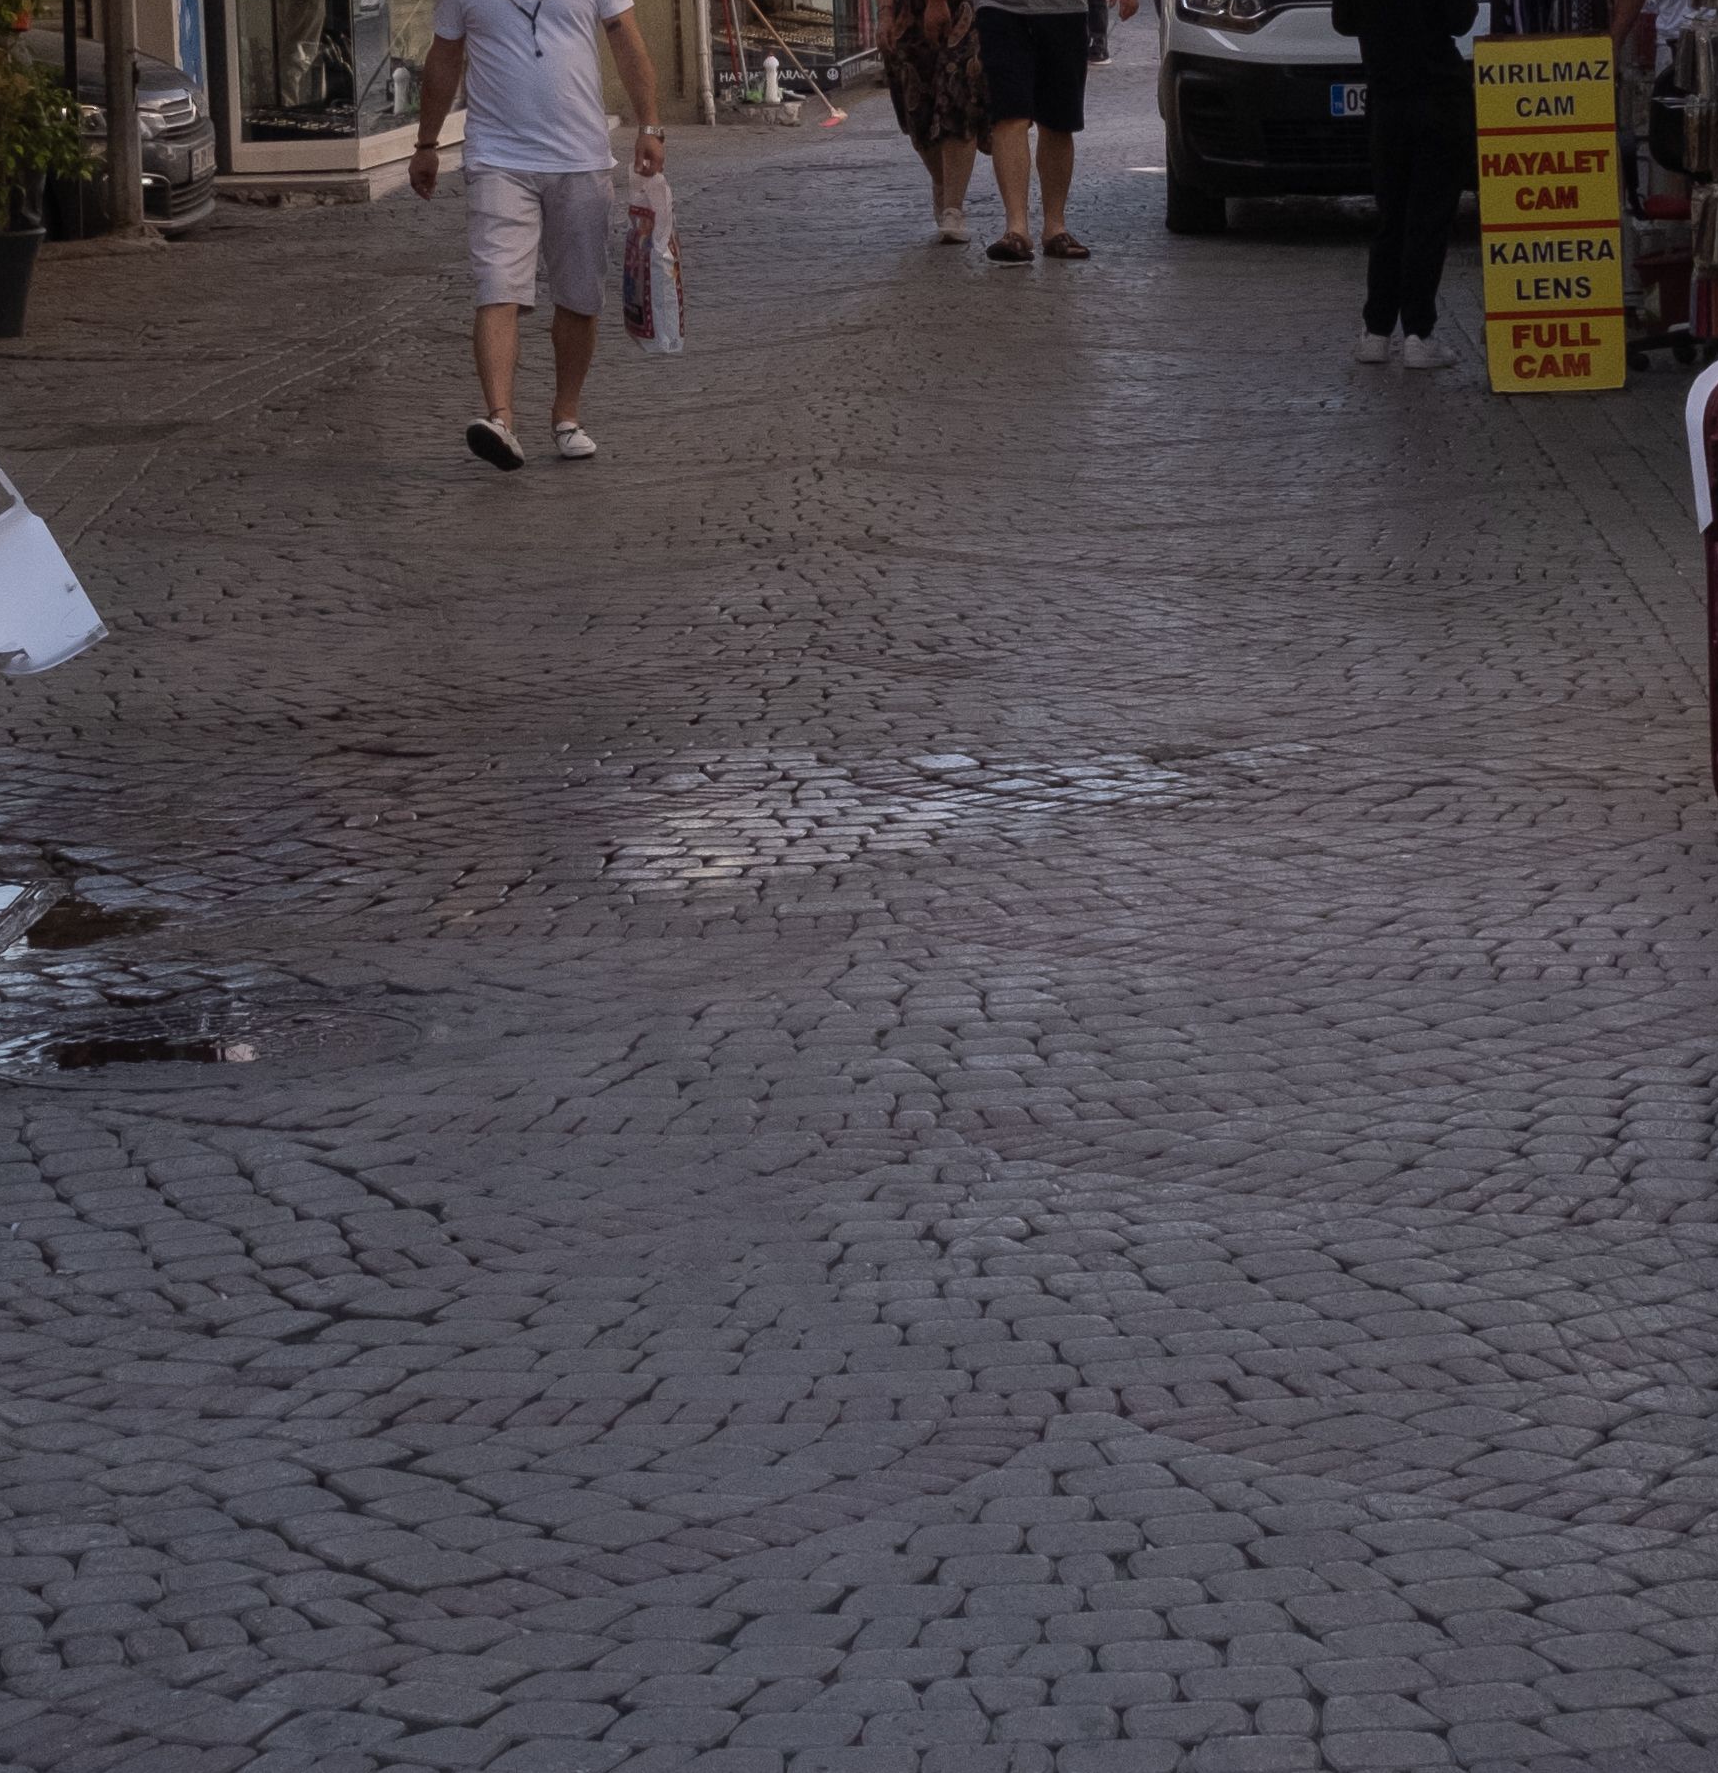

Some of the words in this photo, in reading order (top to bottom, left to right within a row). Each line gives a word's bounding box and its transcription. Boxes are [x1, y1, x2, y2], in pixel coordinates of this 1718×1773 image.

[1478, 60, 1611, 85] KIRILMAZ
[1516, 96, 1574, 117] CAM
[1481, 149, 1610, 177] HAYALET
[1515, 186, 1579, 211] CAM
[1490, 239, 1615, 265] KAMERA
[1516, 276, 1592, 301] LENS
[1512, 322, 1601, 349] FULL
[1513, 353, 1592, 379] CAM
